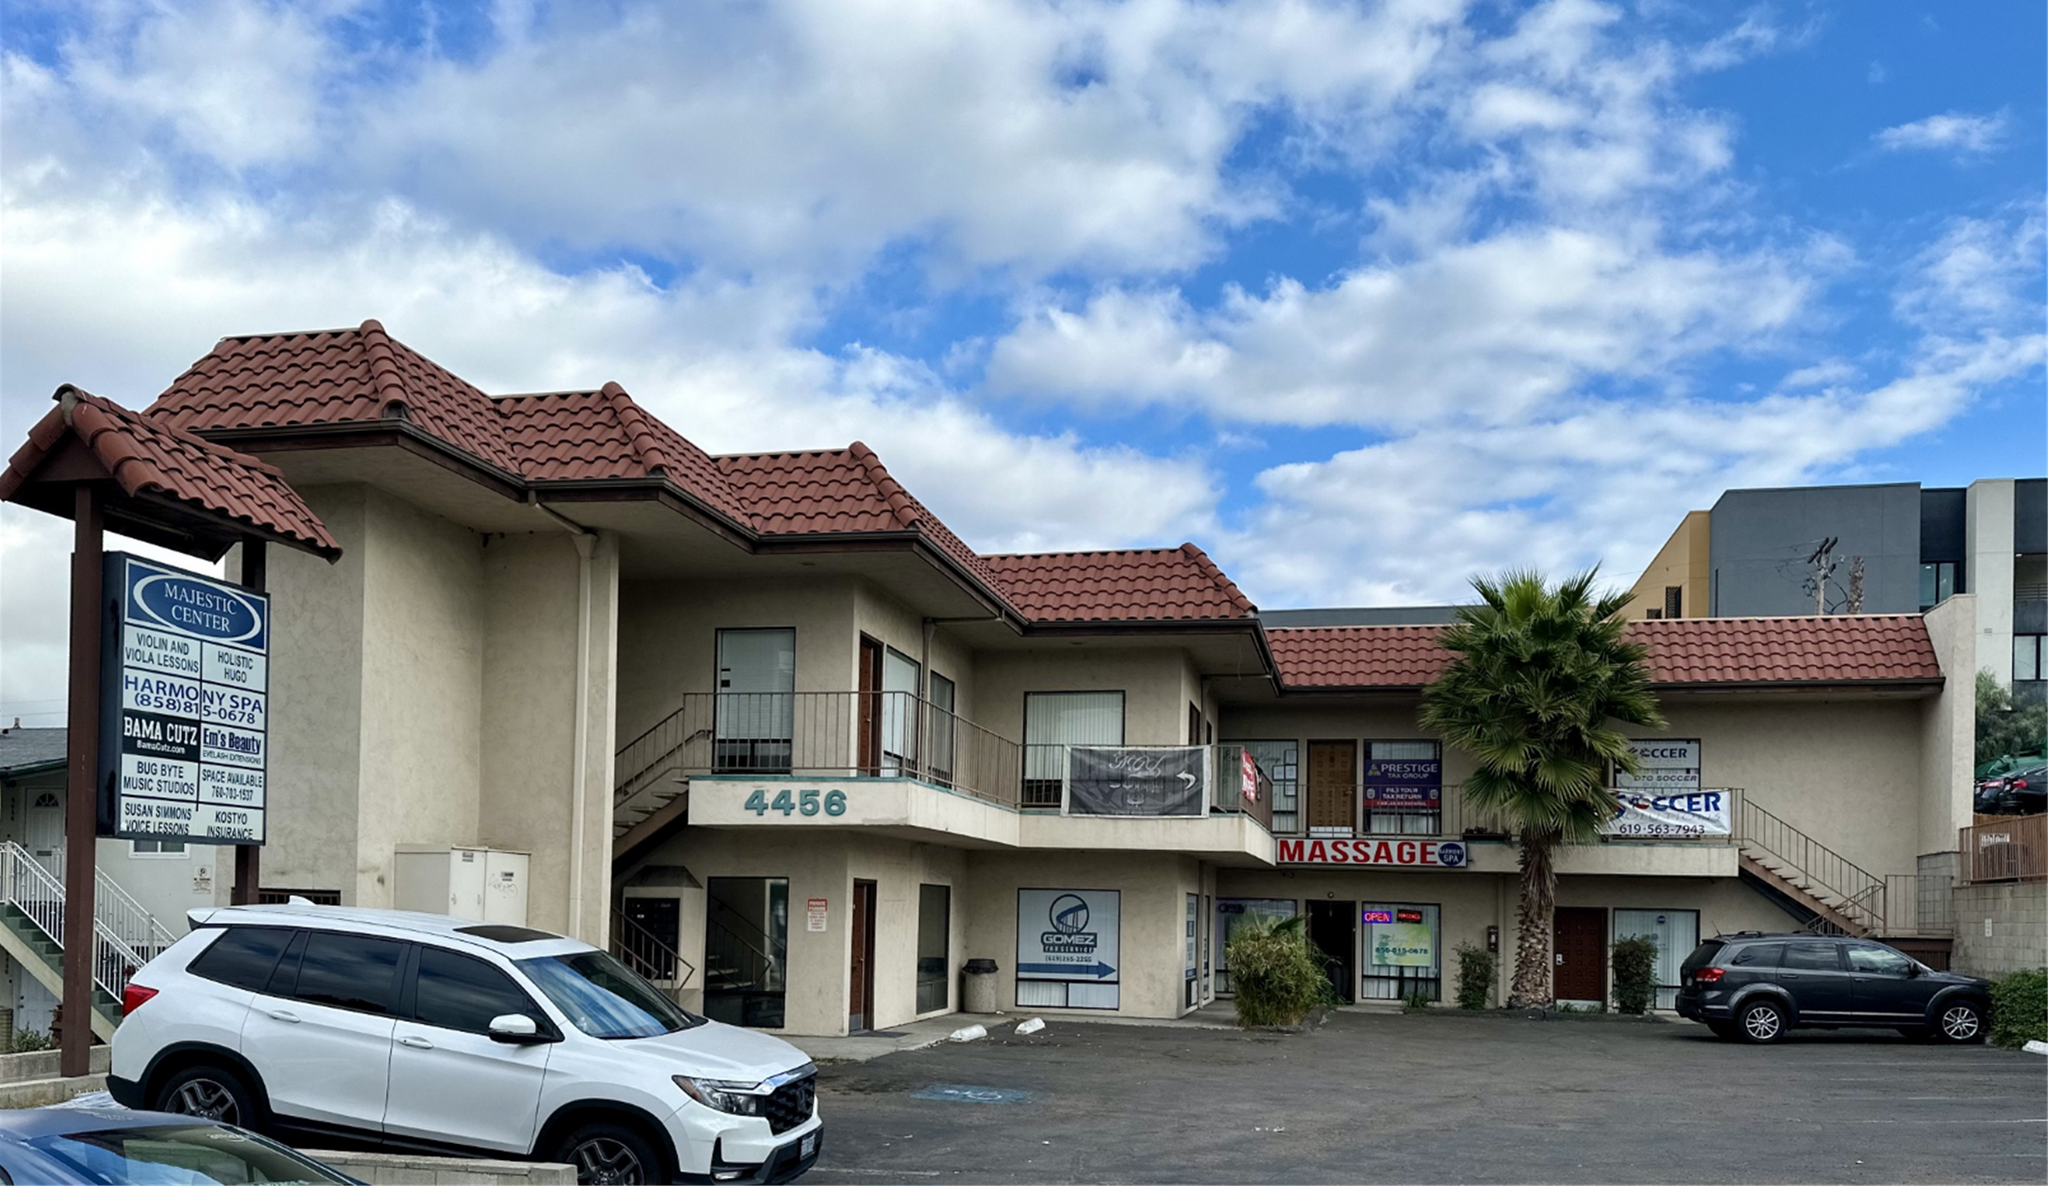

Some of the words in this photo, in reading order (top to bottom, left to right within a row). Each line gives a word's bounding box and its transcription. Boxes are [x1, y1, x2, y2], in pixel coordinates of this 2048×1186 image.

[164, 581, 237, 615] MAJESTIC
[171, 604, 231, 633] CENTER
[137, 632, 168, 652] VIOLIN
[170, 640, 190, 656] AND
[125, 646, 155, 665] VIOLA
[157, 654, 199, 674] LESSONS
[217, 650, 254, 670] HOLISTIC
[223, 667, 248, 684] HUGO
[125, 674, 226, 707] HARMONY
[229, 694, 263, 714] SPA
[134, 692, 256, 725] (858)815-0678
[123, 716, 163, 741] BAMA
[166, 722, 198, 746] CUTZ
[203, 727, 227, 748] Em's
[228, 732, 262, 754] Beauty
[136, 740, 186, 755] BamaCutz.com
[202, 749, 228, 760] EYELASH
[137, 761, 157, 775] BUG
[160, 763, 184, 779] BYTE
[201, 768, 226, 784] SPACE
[226, 773, 263, 788] AVAILABLE
[1381, 763, 1438, 773] PRESTIGE
[123, 776, 154, 792] MUSIC
[156, 779, 195, 796] STUDIOS
[124, 802, 153, 818] SUSAN
[155, 805, 192, 821] SIMMONS
[744, 789, 847, 816] 4456
[125, 819, 151, 834] VOICE
[152, 821, 190, 836] LESSONS
[214, 810, 248, 825] KOSTYO
[206, 825, 254, 841] INSURANCE
[1279, 840, 1438, 864] MASSAGE
[1443, 854, 1459, 862] SPA
[1364, 912, 1390, 922] OPEN
[1043, 934, 1095, 945] GOMEZ
